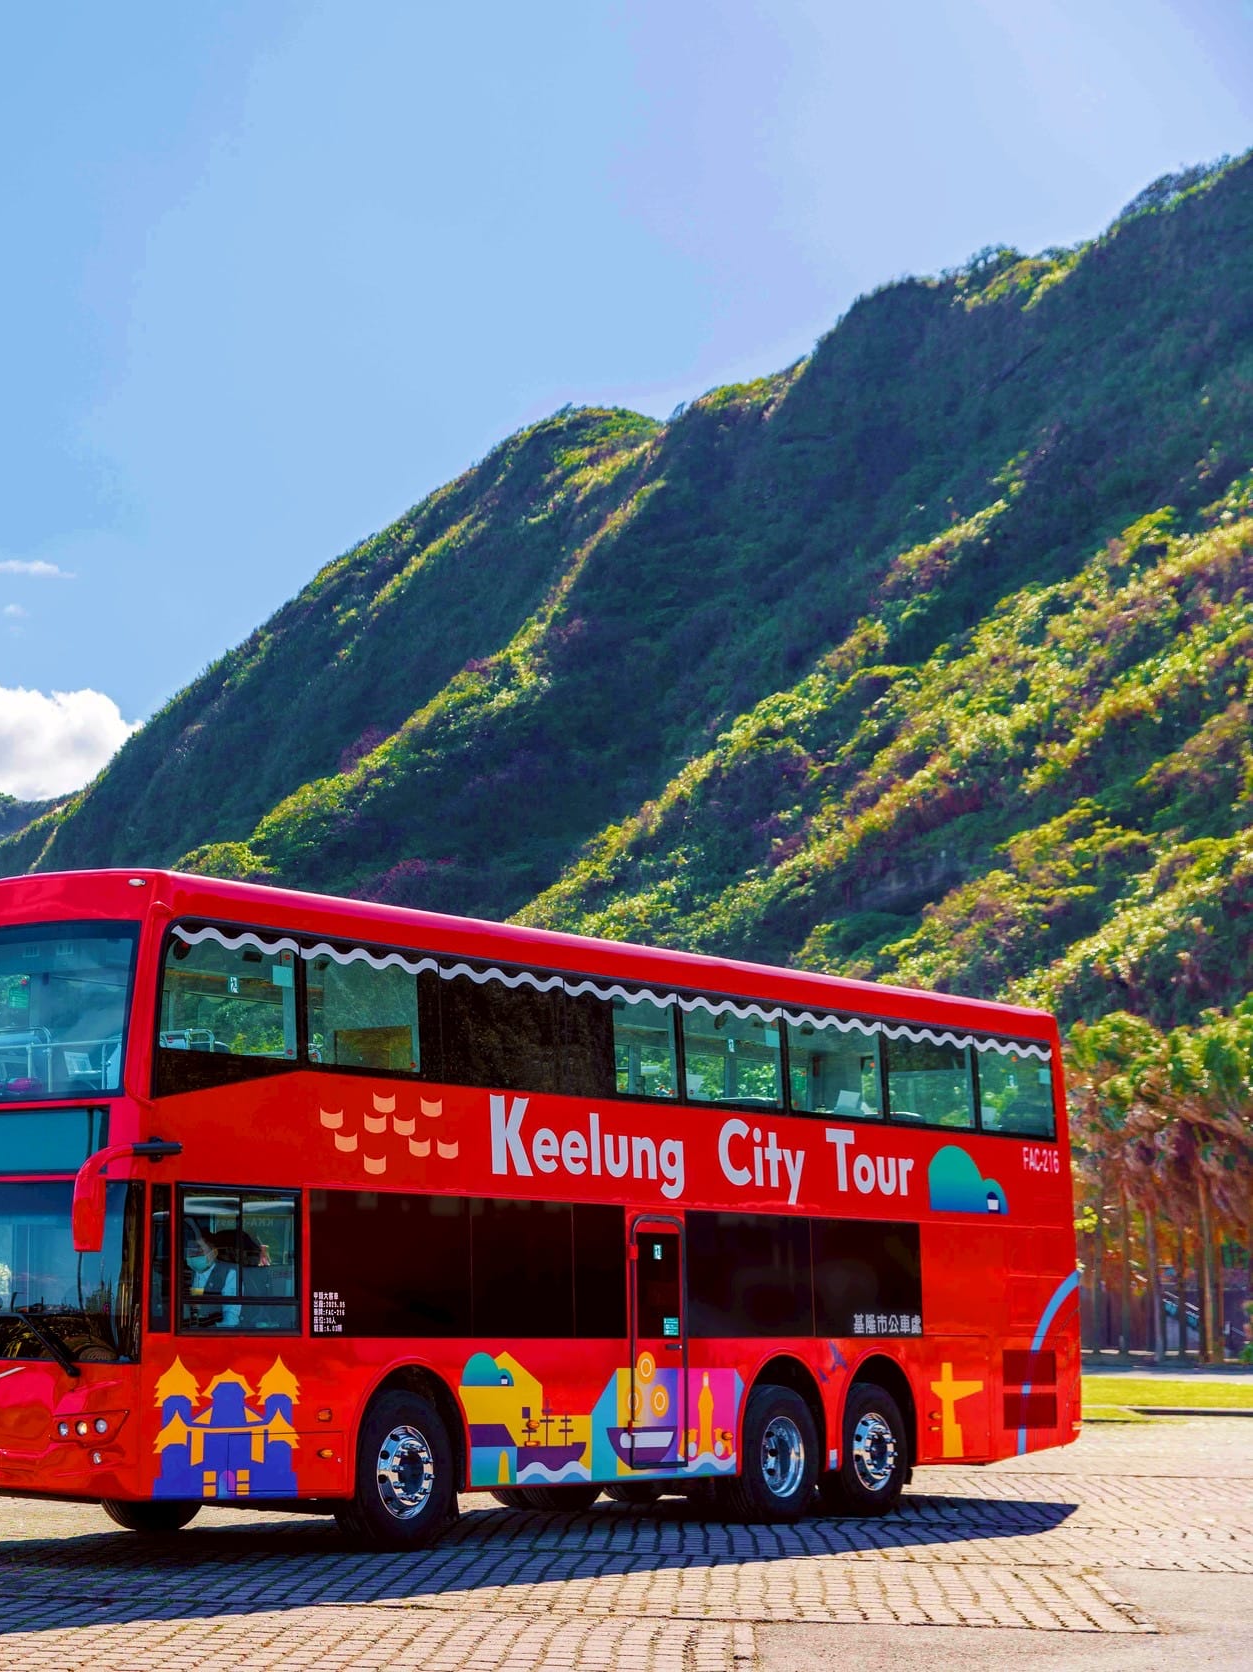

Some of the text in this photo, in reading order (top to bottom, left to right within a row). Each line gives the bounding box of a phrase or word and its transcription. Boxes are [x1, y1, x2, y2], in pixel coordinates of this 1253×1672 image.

[489, 1094, 915, 1206] Keelung City Tour
[1022, 1146, 1060, 1174] FAC-216
[853, 1313, 922, 1334] 基隆市公車處
